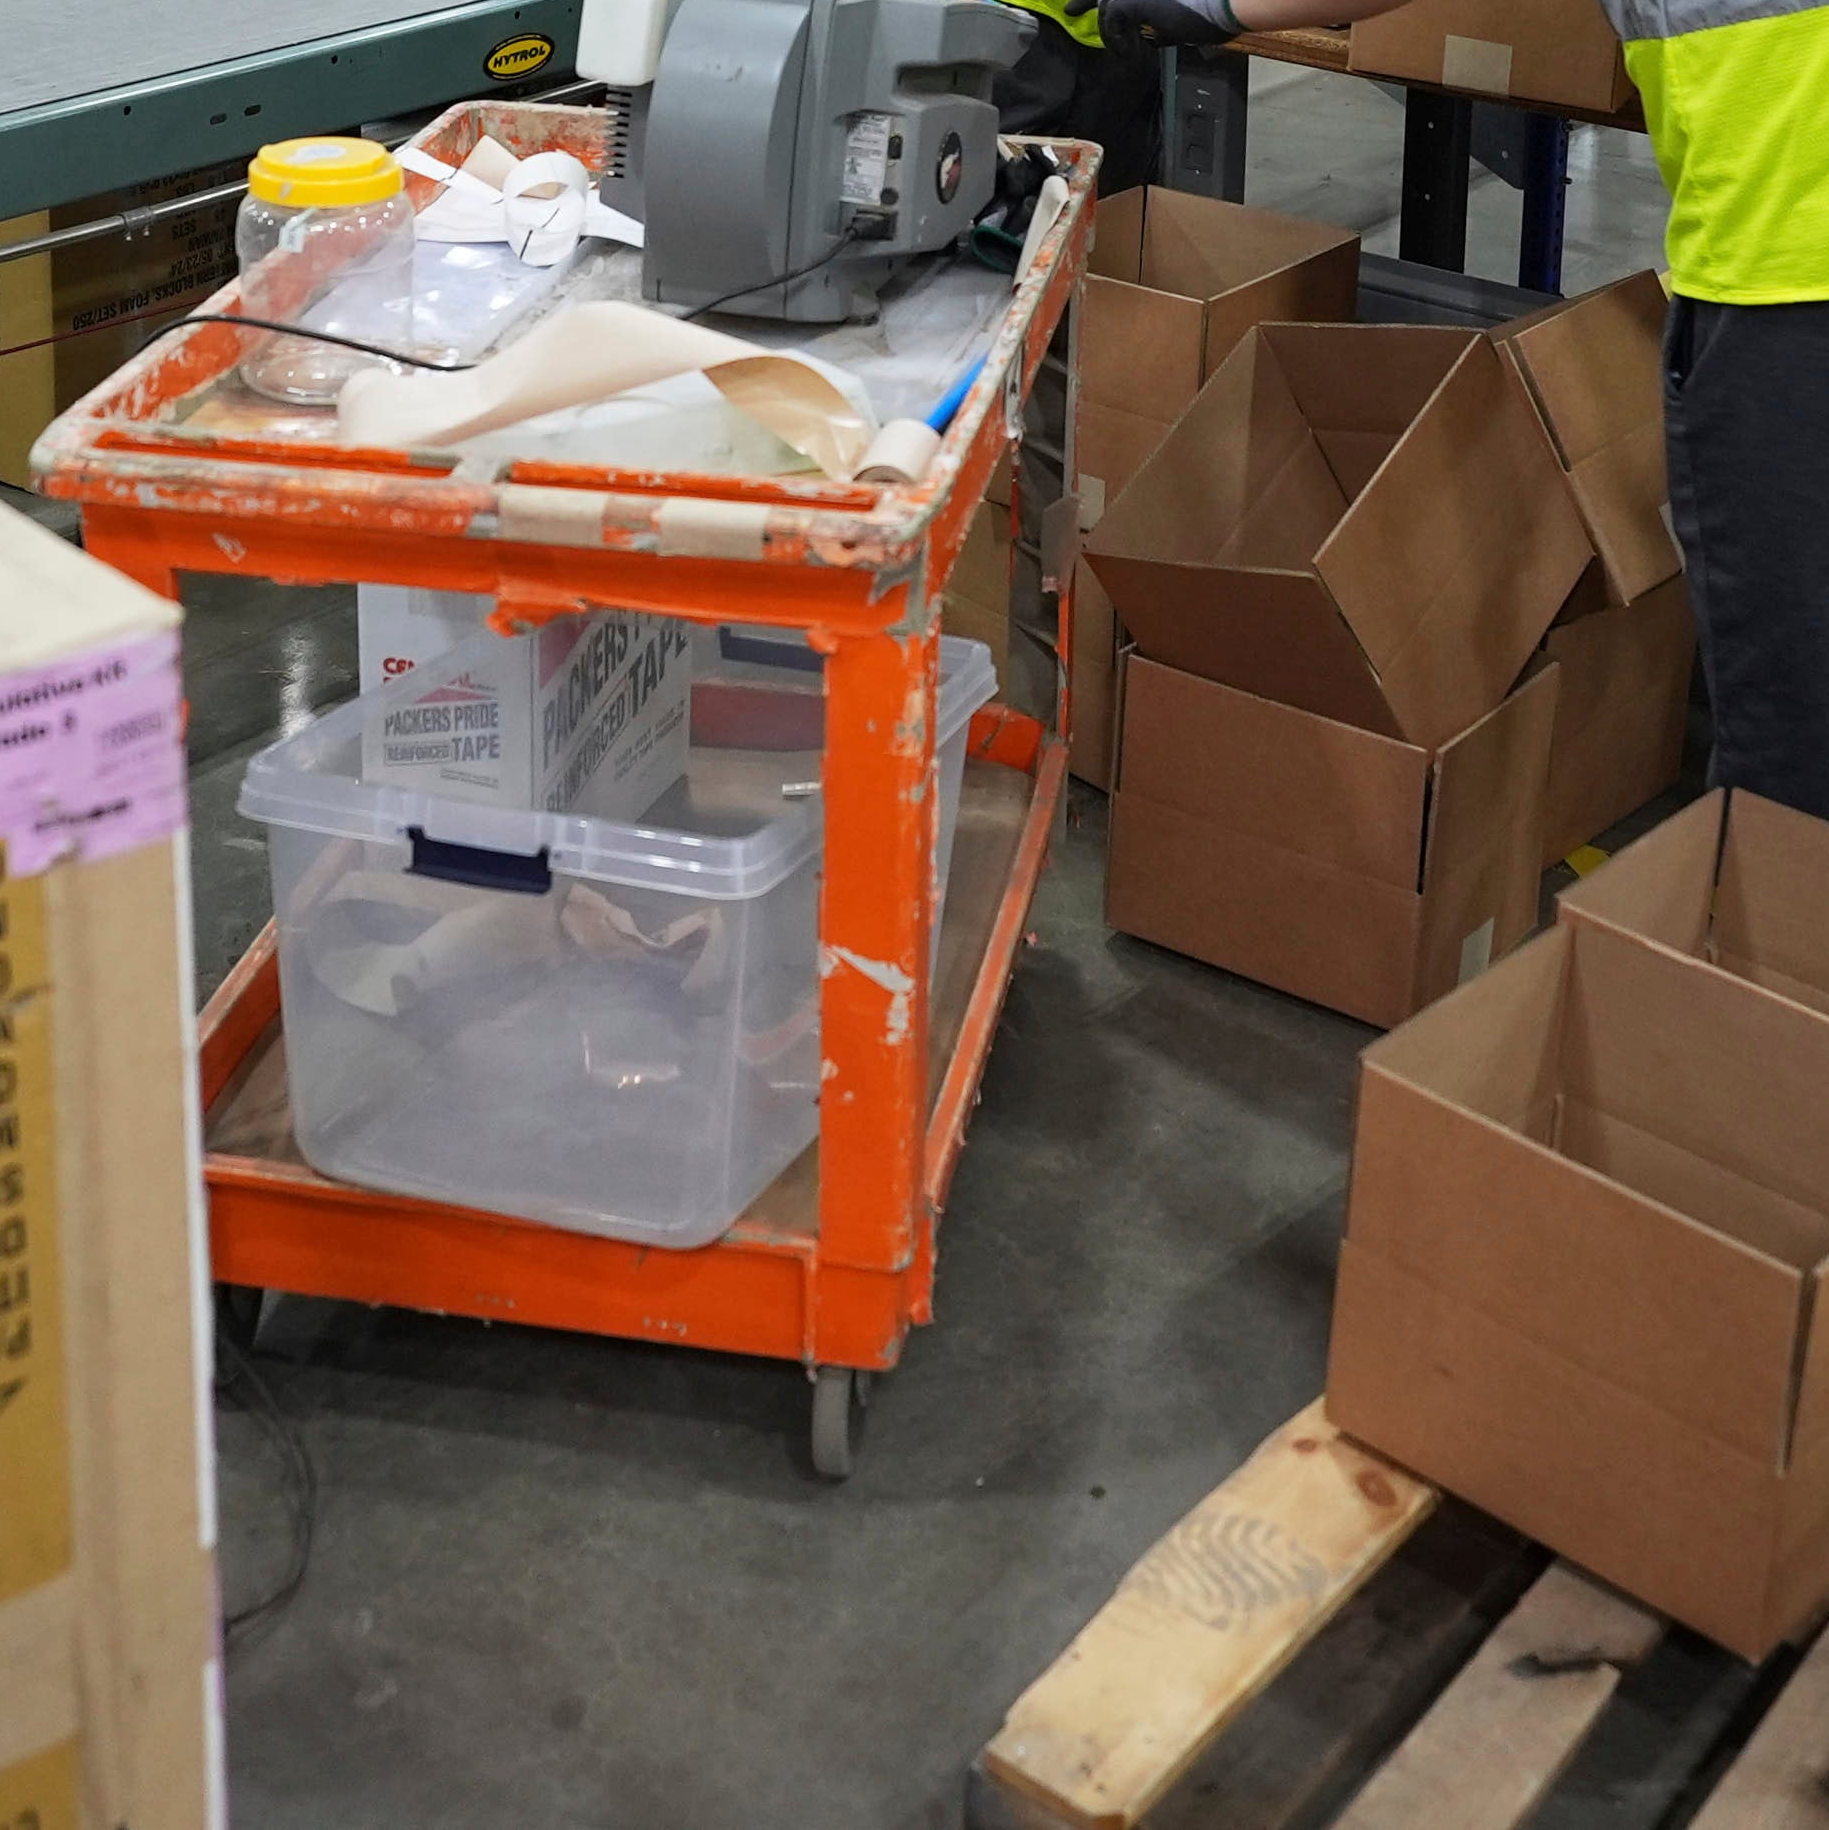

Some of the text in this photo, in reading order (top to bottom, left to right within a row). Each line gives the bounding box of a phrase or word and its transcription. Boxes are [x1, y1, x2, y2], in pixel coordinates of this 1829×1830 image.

[493, 45, 546, 69] HYTROL
[73, 300, 116, 331] SET/250
[120, 290, 150, 316] FOAM
[628, 619, 688, 719] TAPE
[543, 621, 629, 772] PACKERS
[385, 701, 498, 737] PACKERS PRIDE
[452, 734, 500, 762] TAPE
